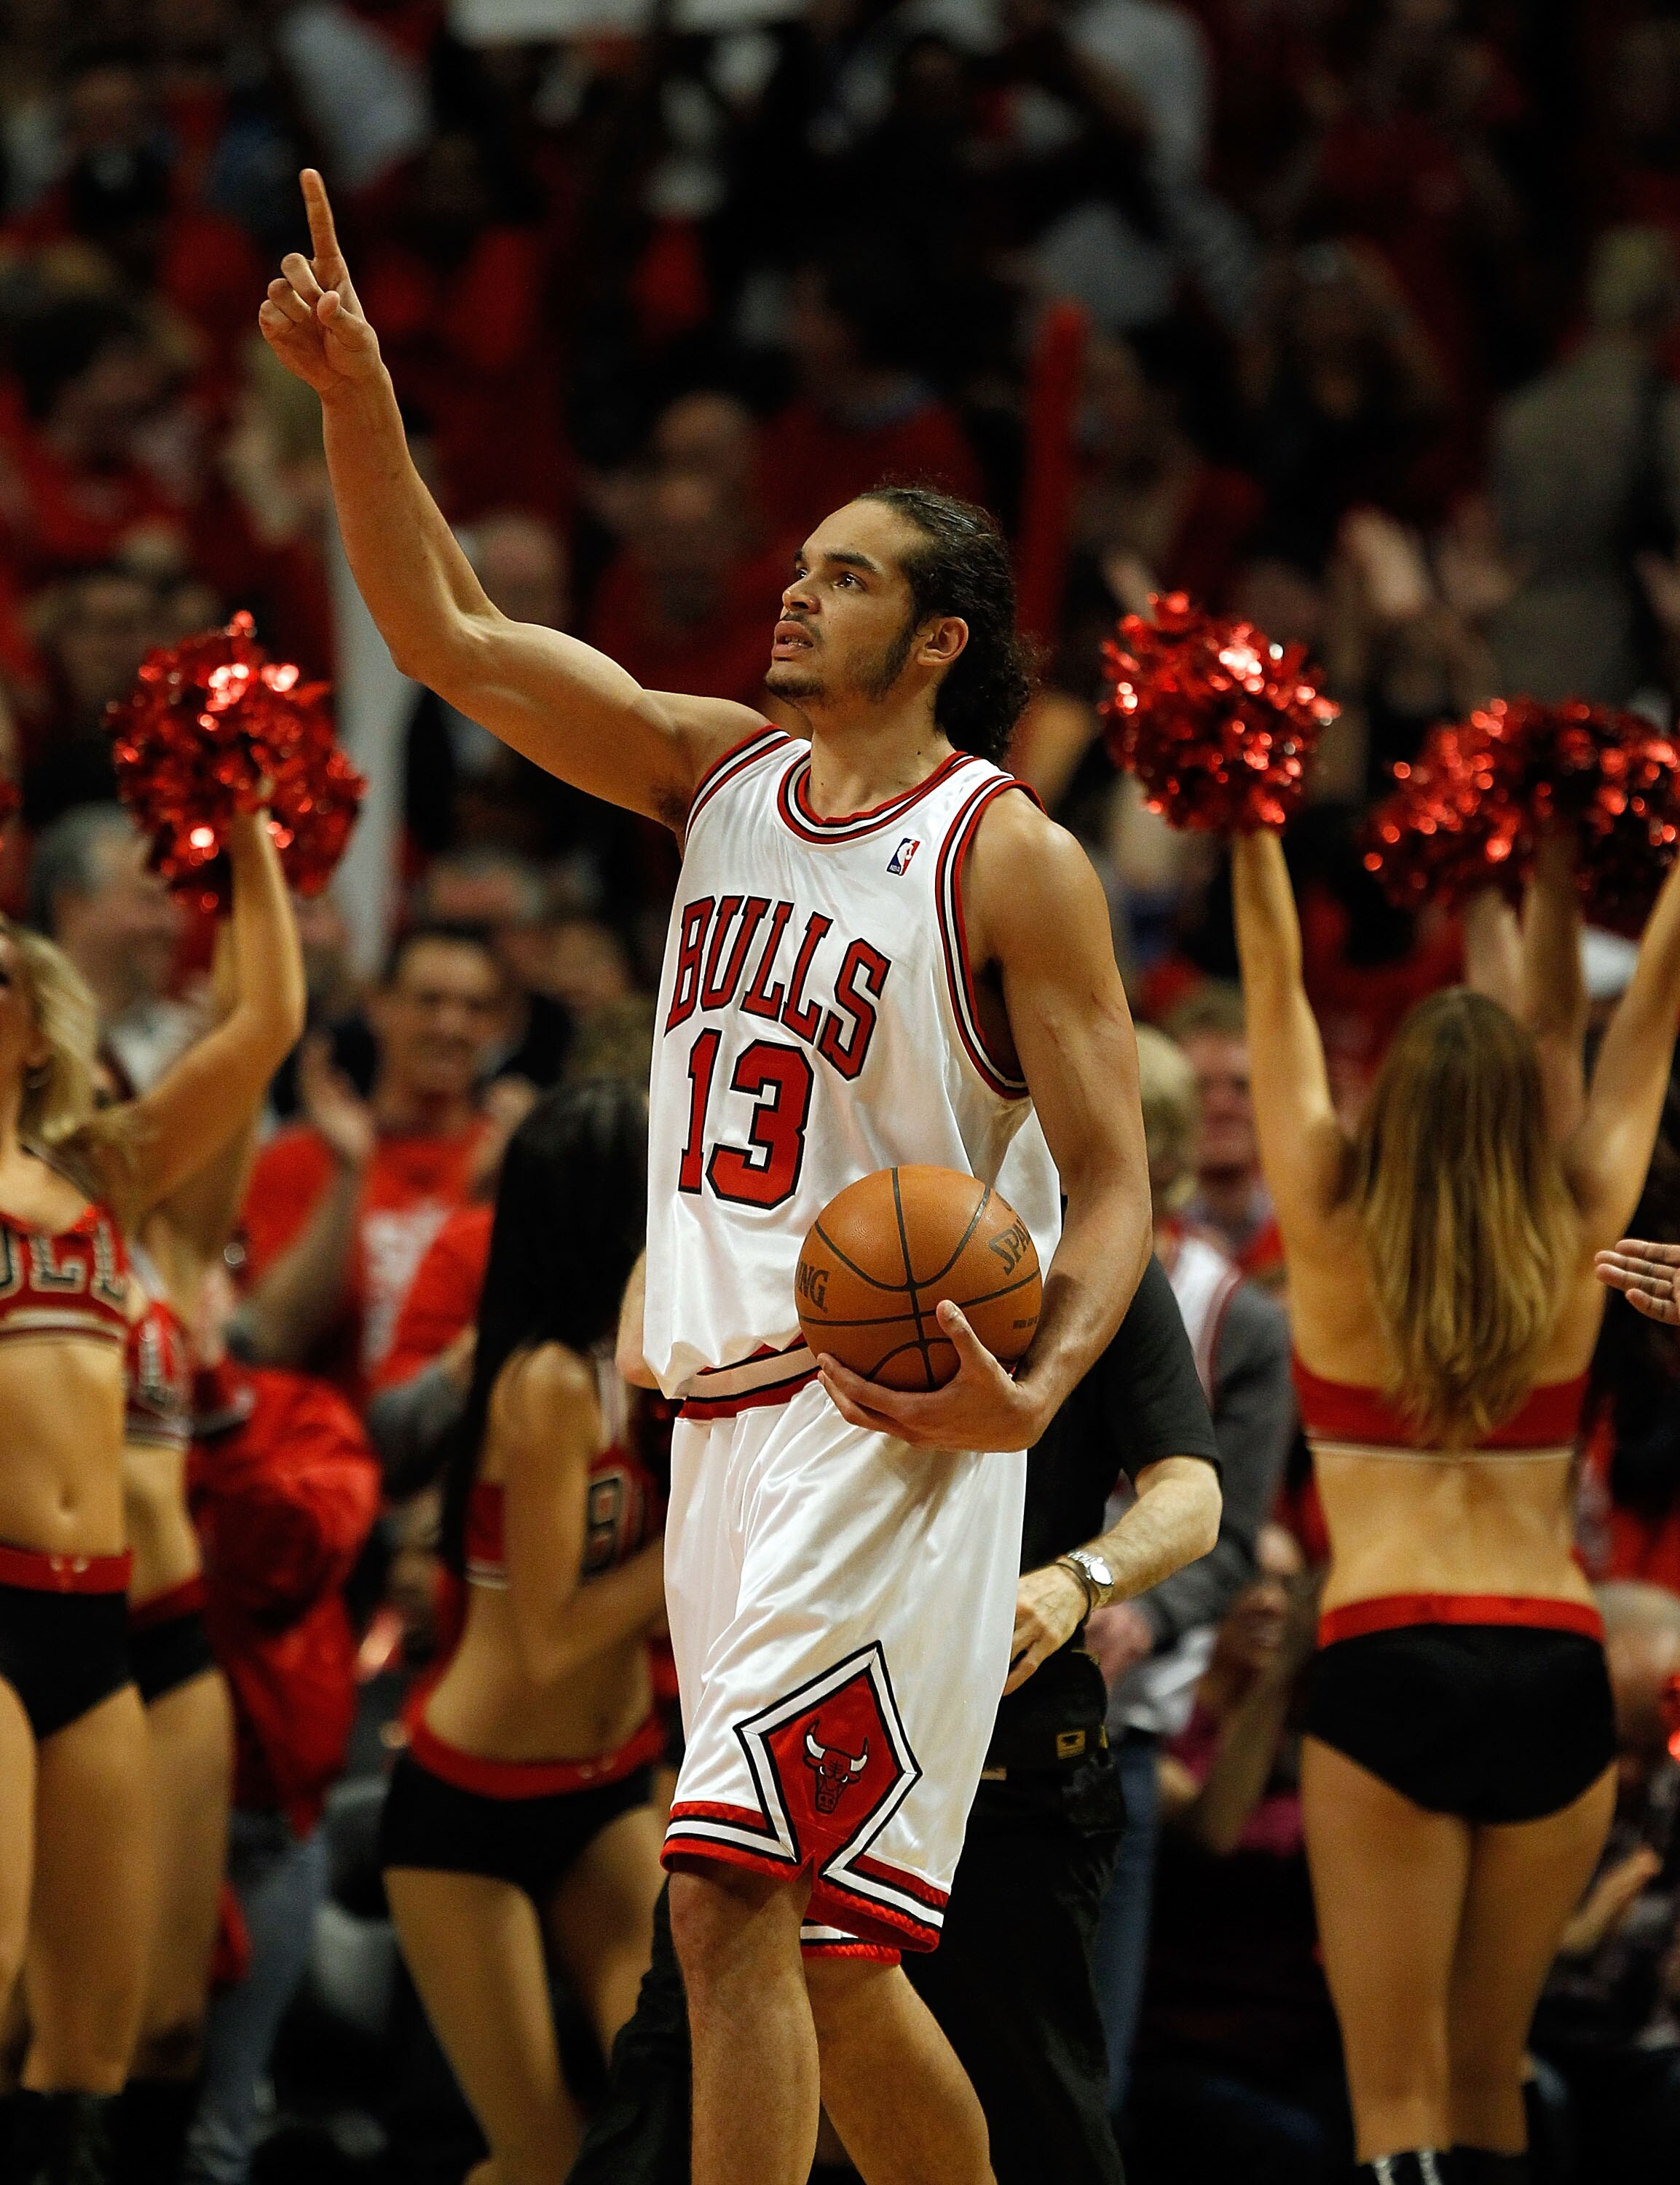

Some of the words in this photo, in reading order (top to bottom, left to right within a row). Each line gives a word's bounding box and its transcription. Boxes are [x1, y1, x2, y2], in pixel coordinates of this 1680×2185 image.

[664, 895, 891, 1082] BULLS
[678, 1028, 814, 1210] 13
[989, 1214, 1031, 1276] SPA
